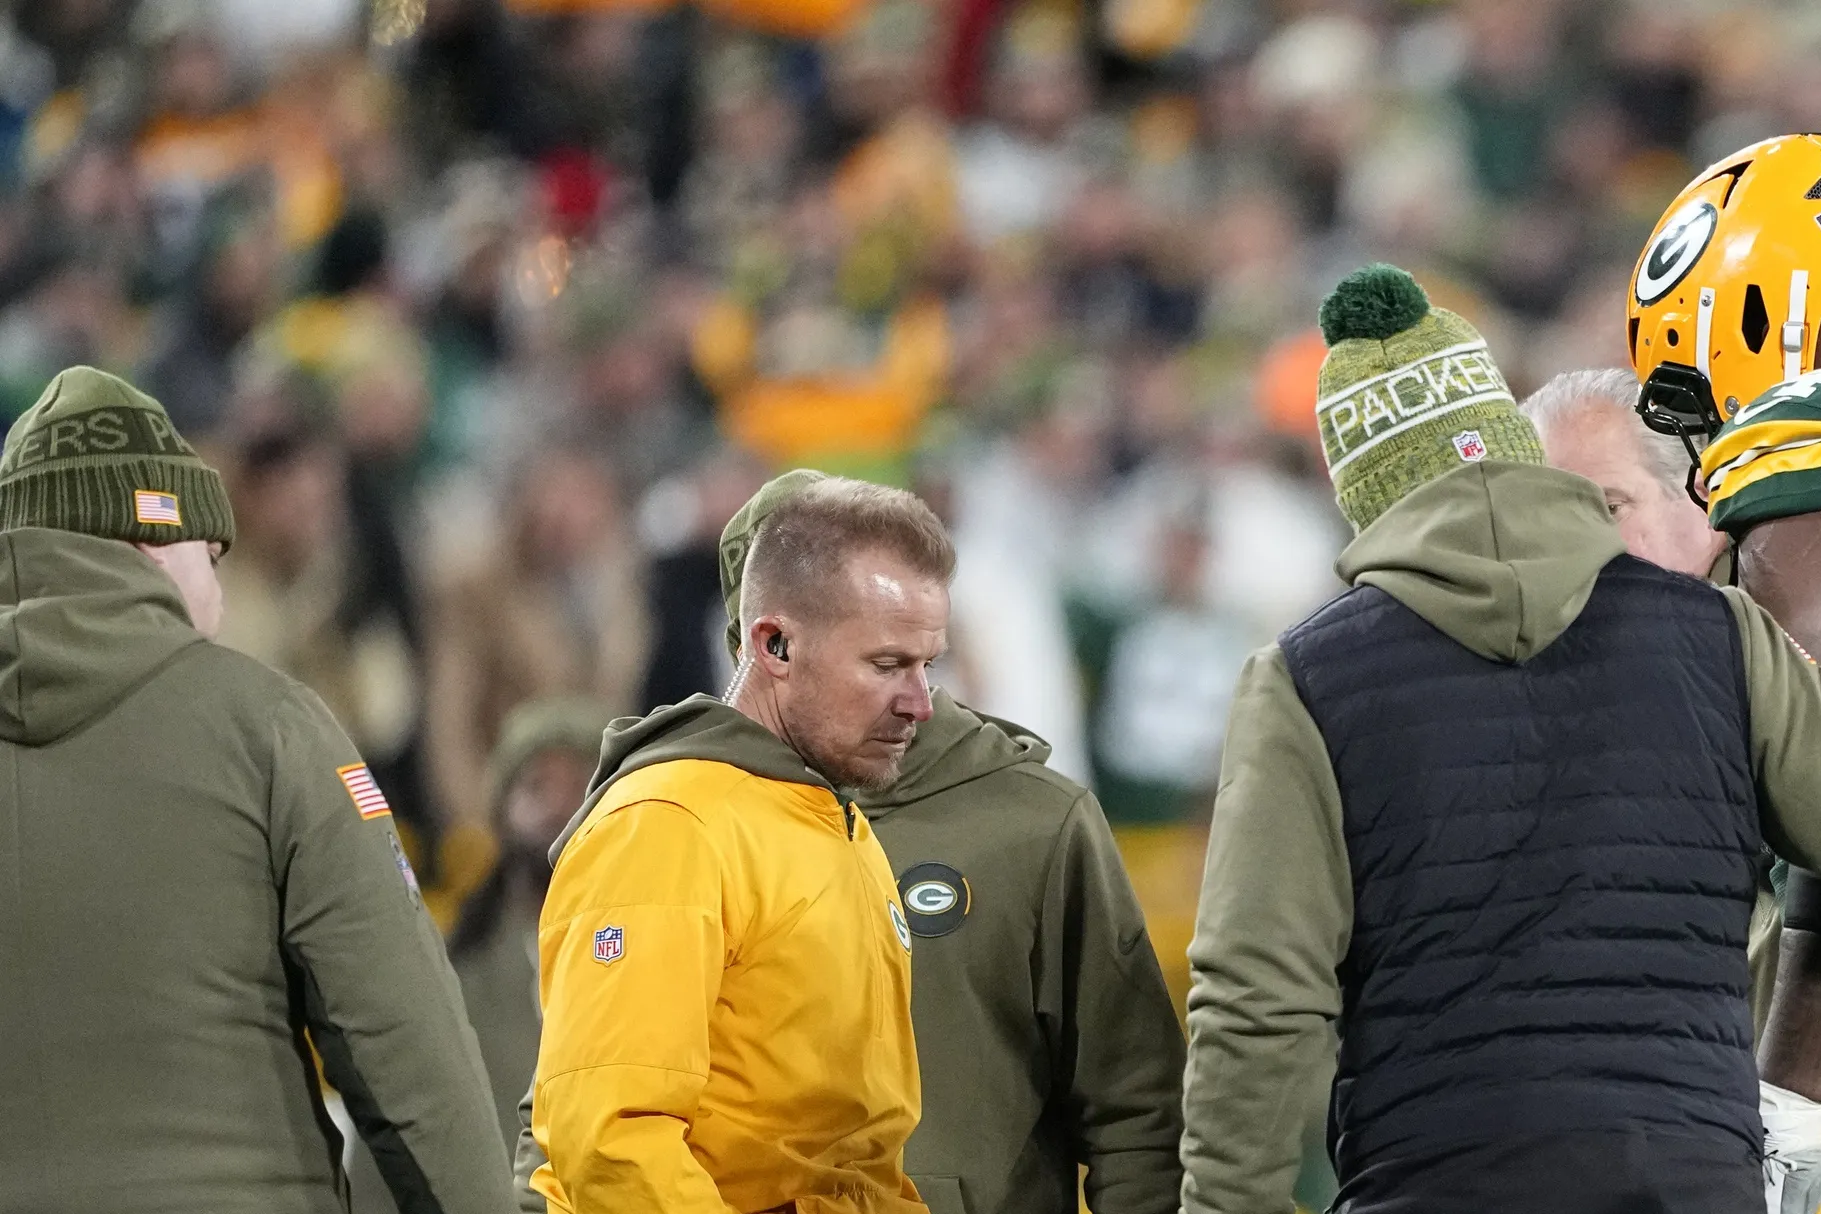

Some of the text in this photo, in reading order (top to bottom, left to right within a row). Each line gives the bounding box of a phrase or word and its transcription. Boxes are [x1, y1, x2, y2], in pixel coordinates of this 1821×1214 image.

[1635, 197, 1717, 306] G
[14, 410, 129, 469] ERS
[905, 882, 957, 915] G
[597, 940, 620, 957] NFL
